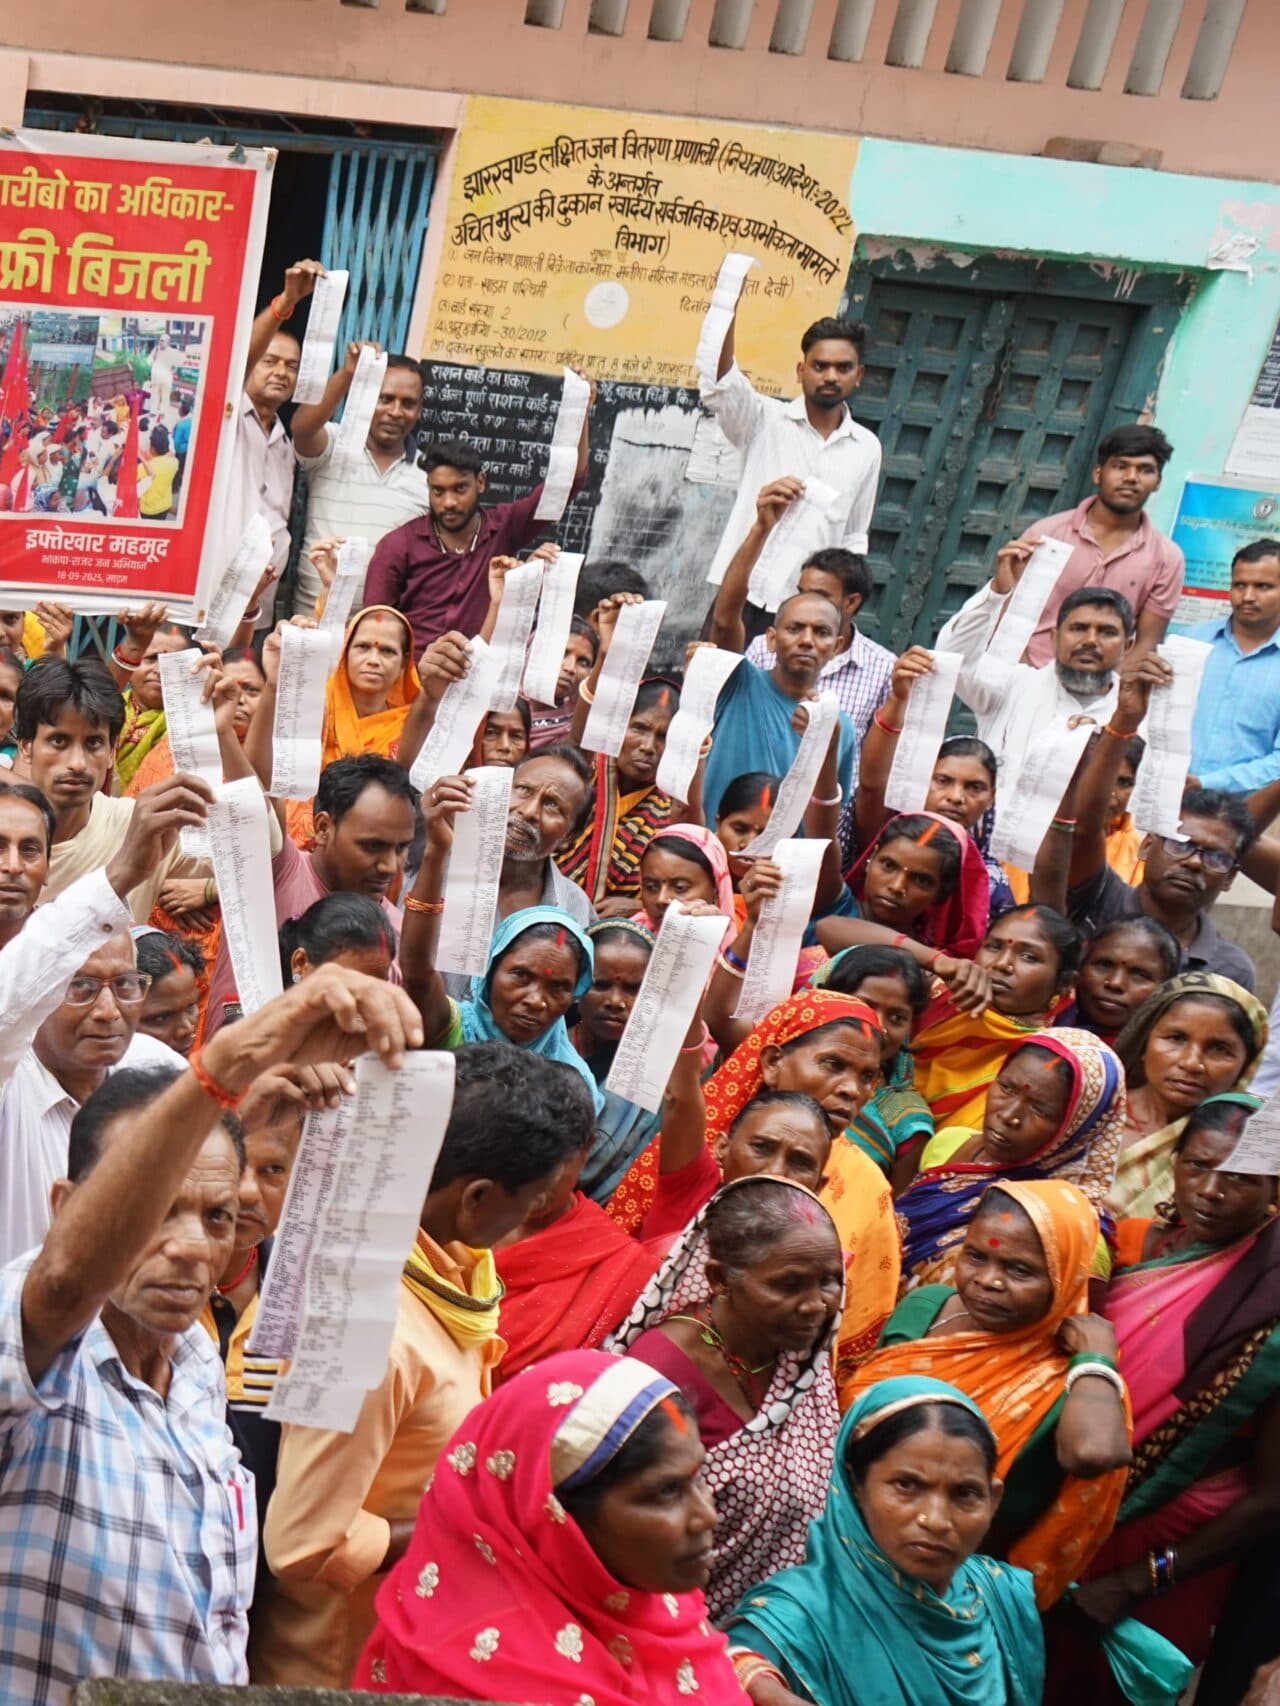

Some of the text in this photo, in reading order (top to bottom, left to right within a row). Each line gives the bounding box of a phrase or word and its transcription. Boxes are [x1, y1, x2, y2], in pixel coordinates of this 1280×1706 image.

[588, 137, 618, 160] जन
[622, 129, 673, 163] वितरण
[672, 138, 720, 166] प्रणाली
[73, 180, 112, 214] का
[116, 176, 235, 222] अधिकार-
[587, 164, 663, 197] के अन्तर्गत
[451, 213, 495, 245] उचित
[533, 188, 556, 222] की
[557, 193, 604, 226] दुकान
[796, 243, 841, 285] मामले
[66, 232, 212, 304] बिजली
[431, 364, 463, 381] राशन
[464, 363, 486, 384] कार्ड
[487, 371, 501, 387] का
[25, 525, 170, 563] इफ्तेखार महमूद
[95, 558, 111, 568] जन
[112, 557, 147, 570] अभियान
